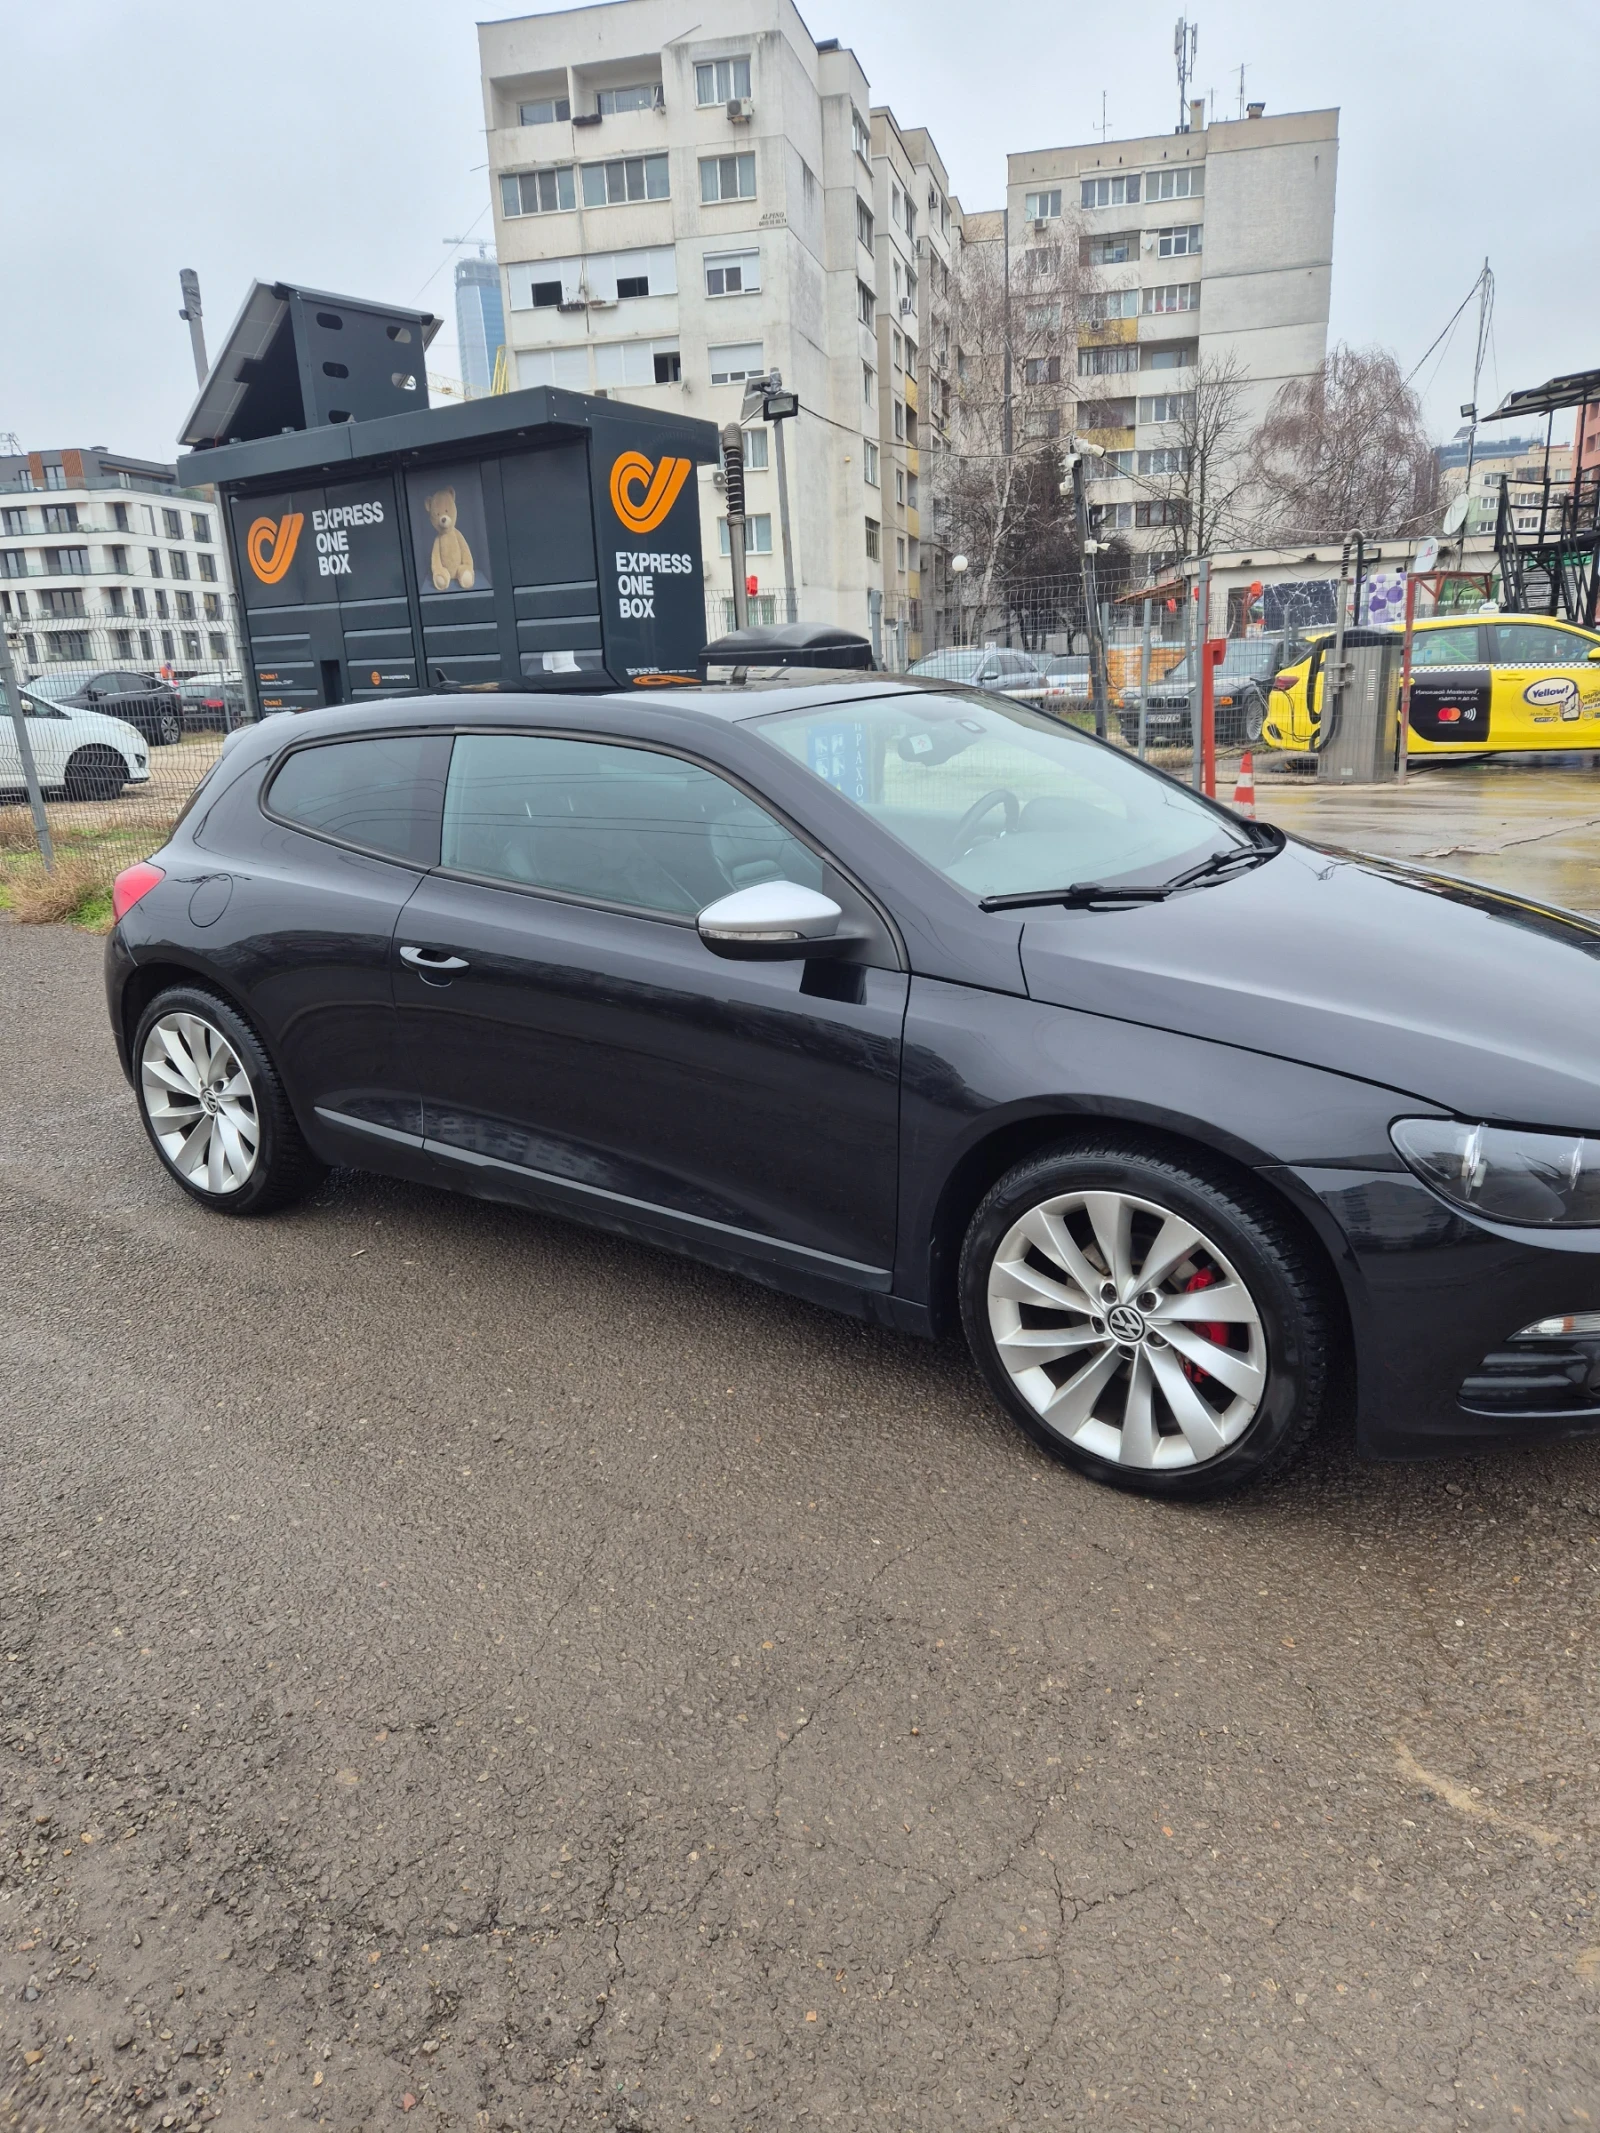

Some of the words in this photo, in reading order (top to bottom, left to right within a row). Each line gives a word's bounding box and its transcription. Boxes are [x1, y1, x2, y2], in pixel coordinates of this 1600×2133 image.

[312, 501, 384, 531] EXPRESS
[316, 530, 350, 553] ONE
[318, 553, 352, 576] BOX
[615, 551, 692, 574] EXPRESS
[618, 574, 654, 596] ONE
[619, 597, 656, 618] BOX
[1533, 685, 1569, 698] Yellow!
